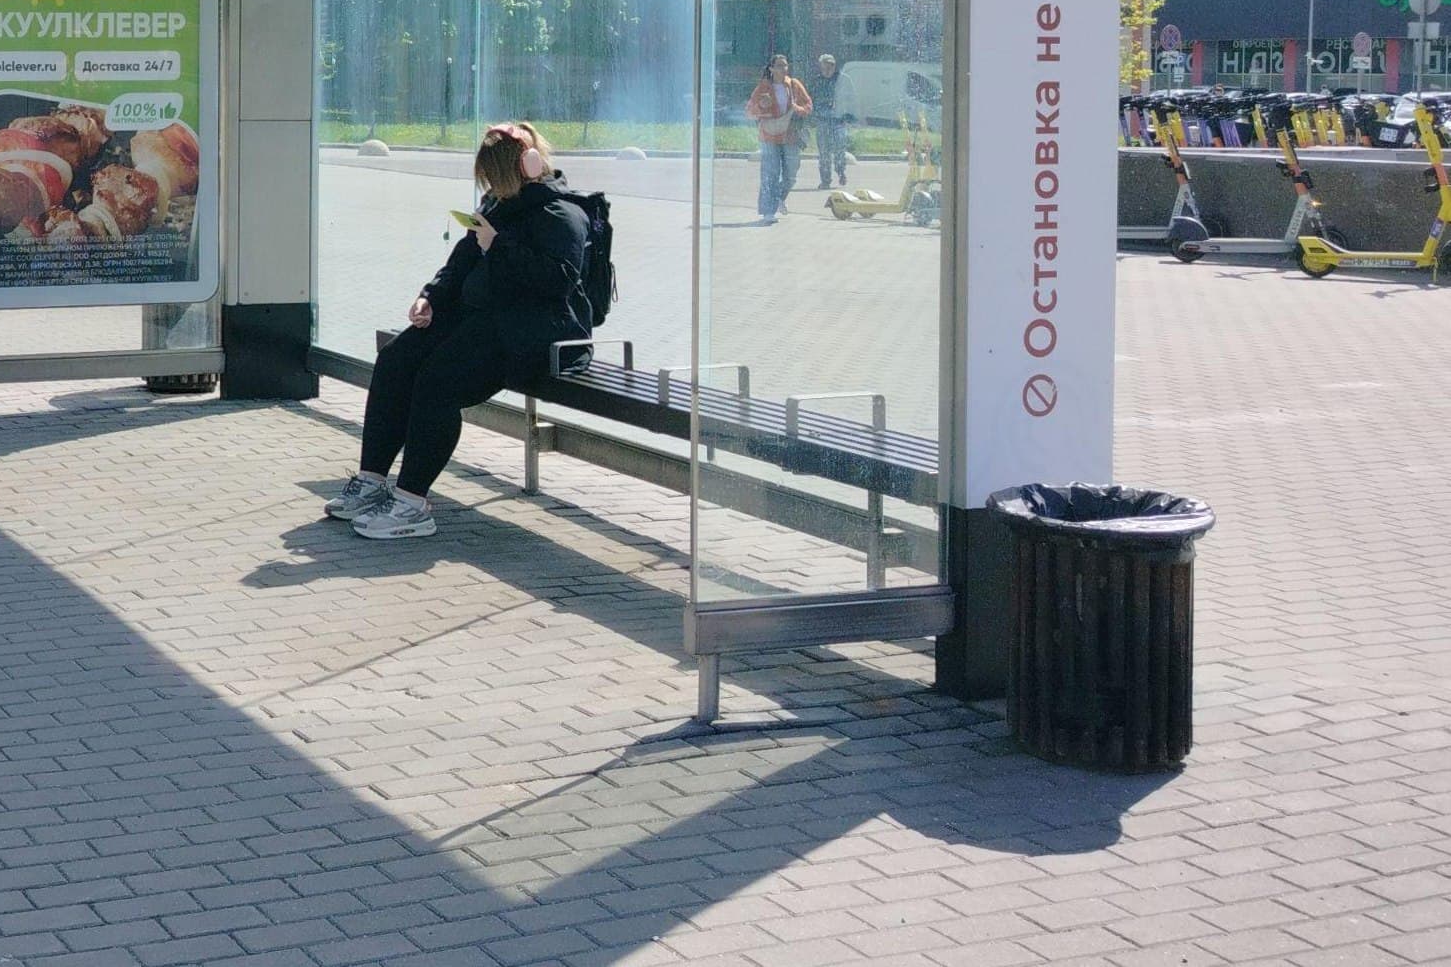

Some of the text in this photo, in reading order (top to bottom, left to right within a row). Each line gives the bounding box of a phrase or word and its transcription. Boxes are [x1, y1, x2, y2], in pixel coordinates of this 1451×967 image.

[1036, 3, 1061, 62] не
[82, 60, 173, 73] Доставка 24/7
[114, 103, 157, 117] 100%
[1023, 81, 1061, 358] Остановка
